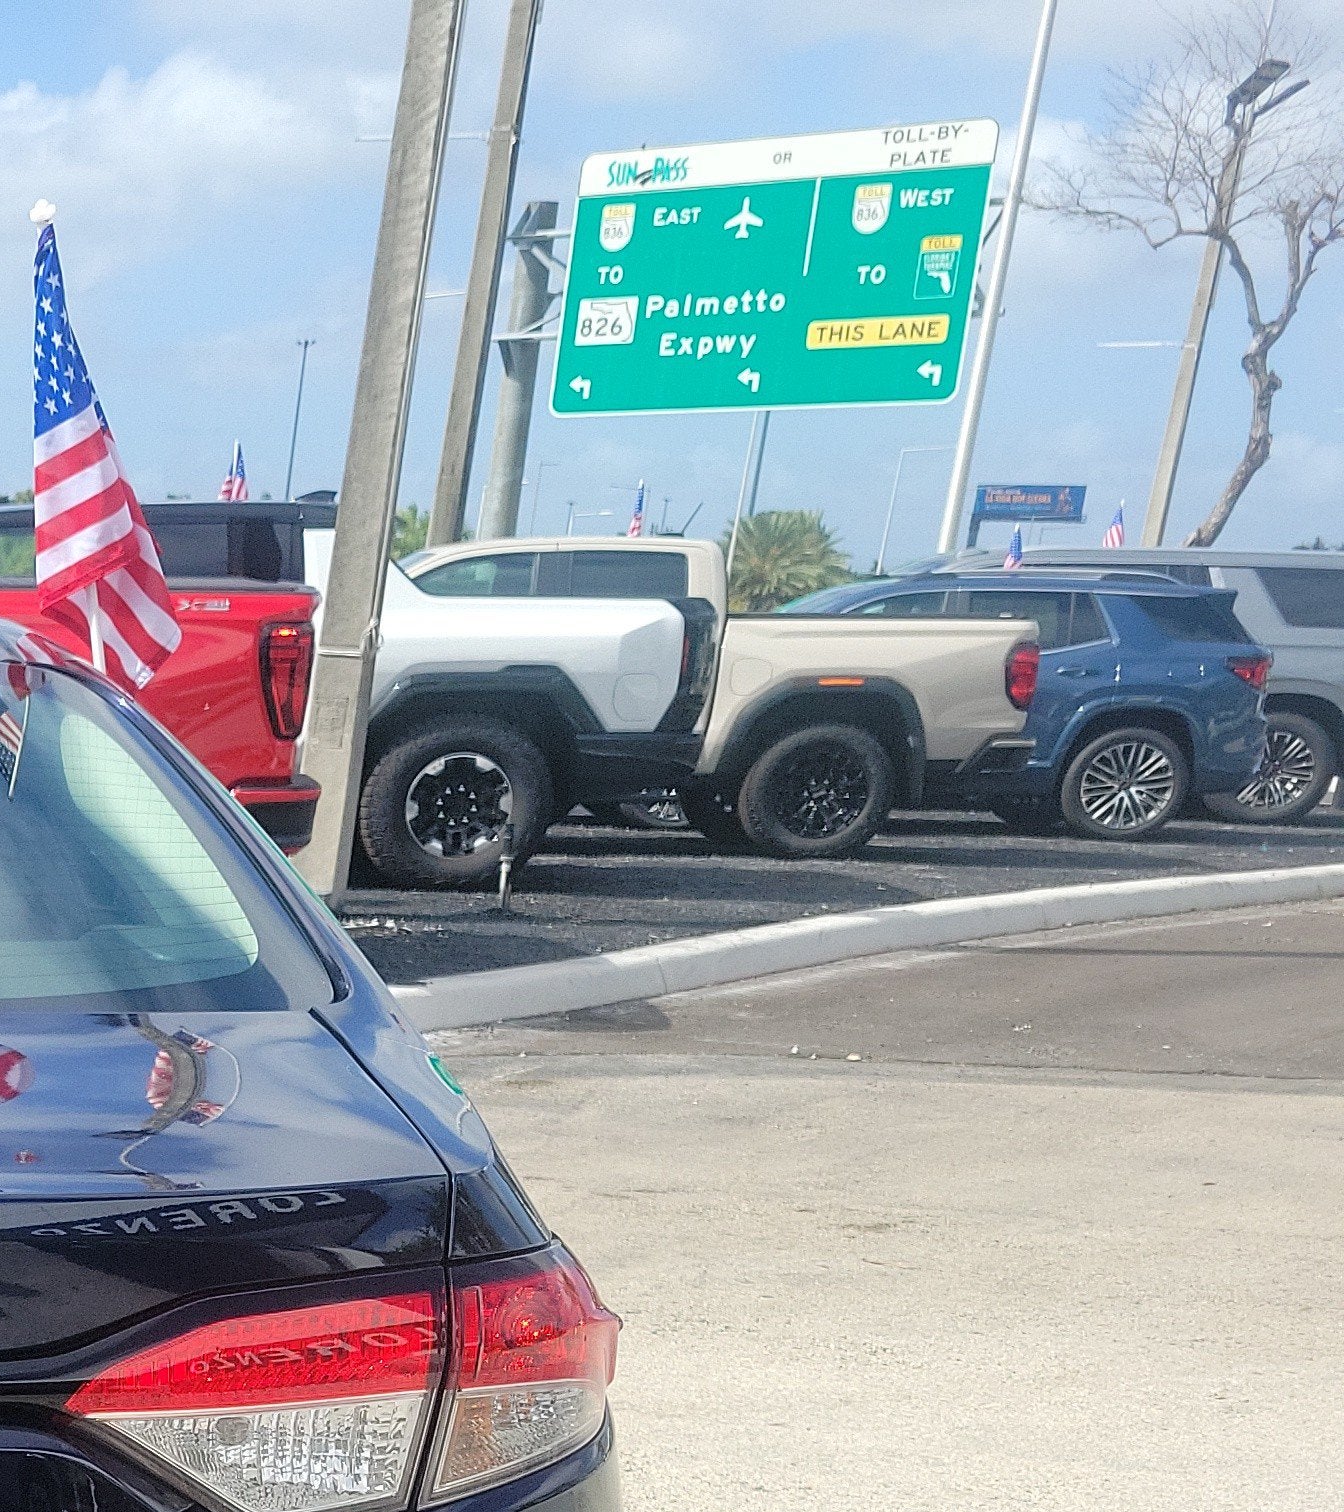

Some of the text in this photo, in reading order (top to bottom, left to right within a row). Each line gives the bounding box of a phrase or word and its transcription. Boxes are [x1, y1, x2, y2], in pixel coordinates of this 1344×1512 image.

[773, 151, 793, 165] OR
[889, 148, 952, 168] PLATE
[862, 188, 886, 197] TOLL
[899, 188, 955, 208] WEST
[652, 206, 702, 227] EAST
[856, 207, 879, 222] 836
[928, 239, 957, 250] TOLL
[597, 264, 624, 285] TO
[856, 264, 887, 285] TO
[645, 288, 787, 319] Palmetto
[580, 317, 623, 338] 826
[816, 321, 941, 343] THIS LANE
[658, 331, 758, 361] Expwy
